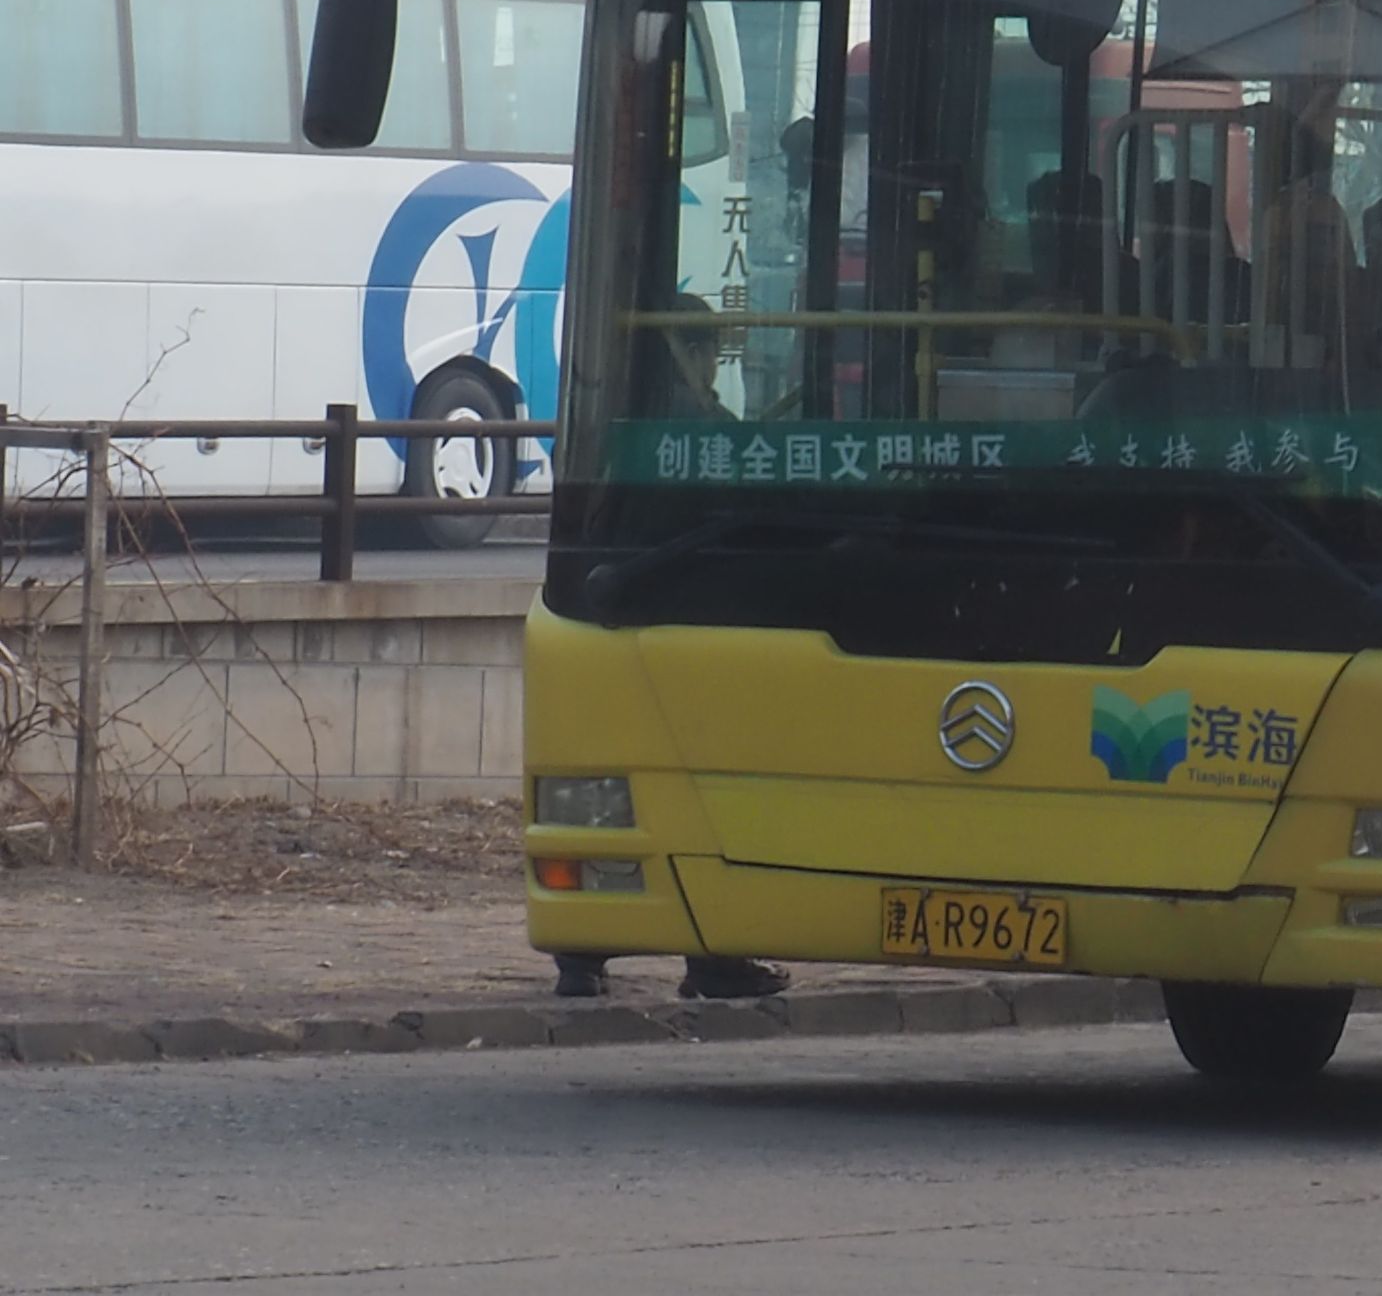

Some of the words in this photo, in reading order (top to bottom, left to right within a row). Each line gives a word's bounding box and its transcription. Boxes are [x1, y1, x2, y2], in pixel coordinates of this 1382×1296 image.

[655, 433, 1007, 481] 创建全国文明城区
[1190, 705, 1300, 767] 滨海
[1188, 767, 1234, 787] Tianjin
